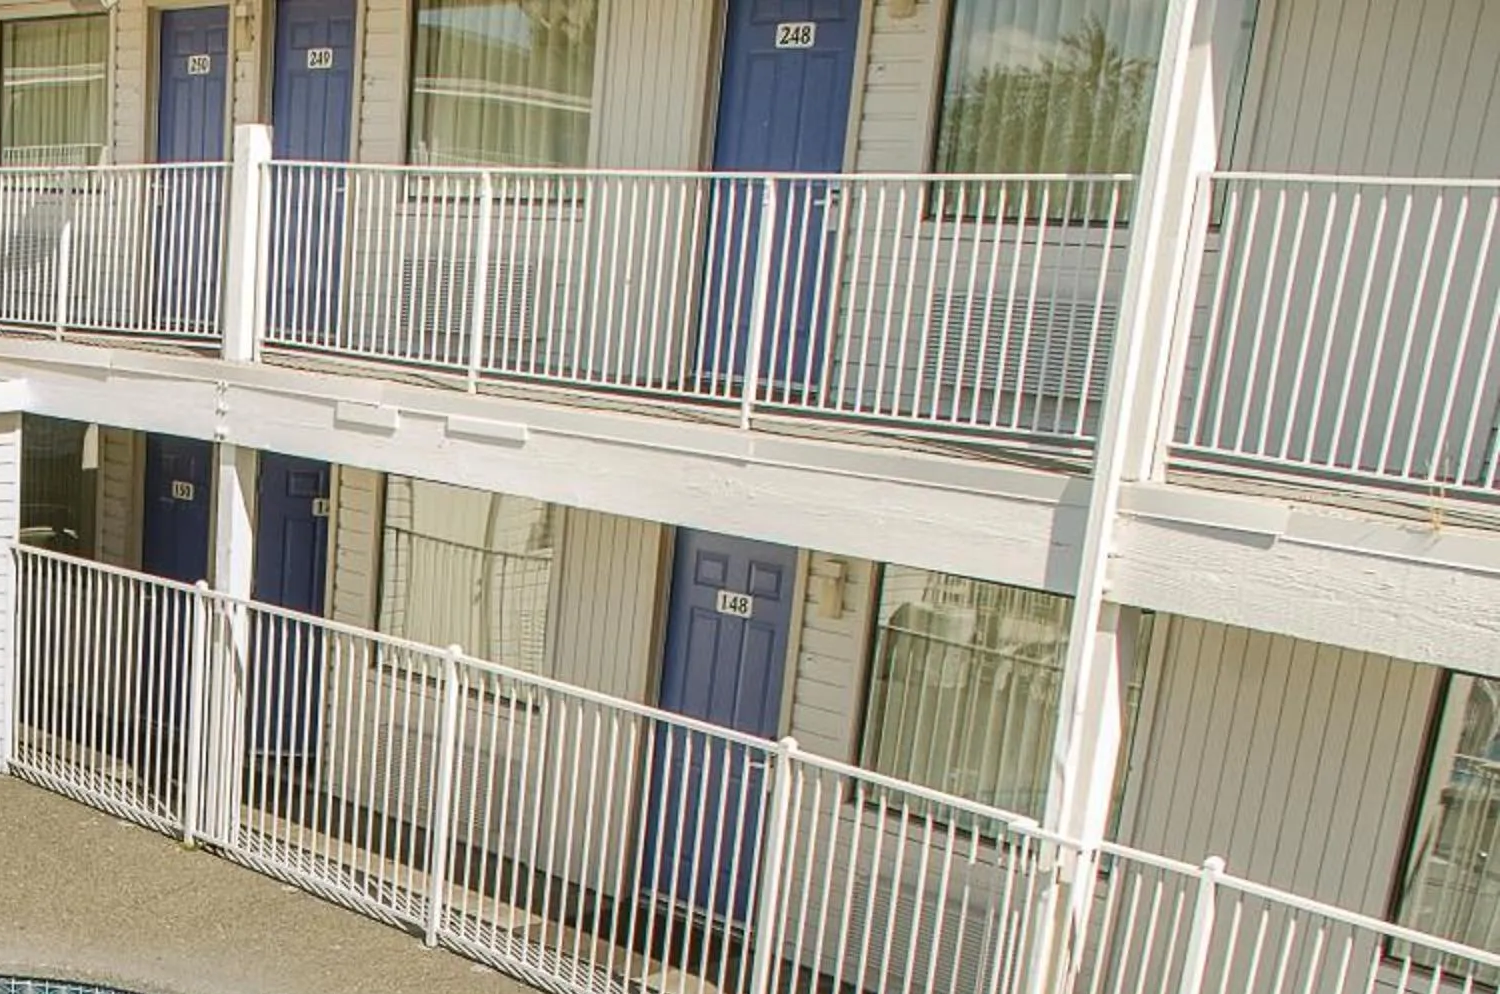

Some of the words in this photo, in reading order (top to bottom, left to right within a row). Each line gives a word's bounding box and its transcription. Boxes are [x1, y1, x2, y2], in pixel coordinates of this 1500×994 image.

[780, 25, 811, 45] 248
[190, 56, 208, 73] 250
[309, 50, 331, 67] 249
[174, 482, 191, 498] 150
[721, 594, 749, 615] 148
